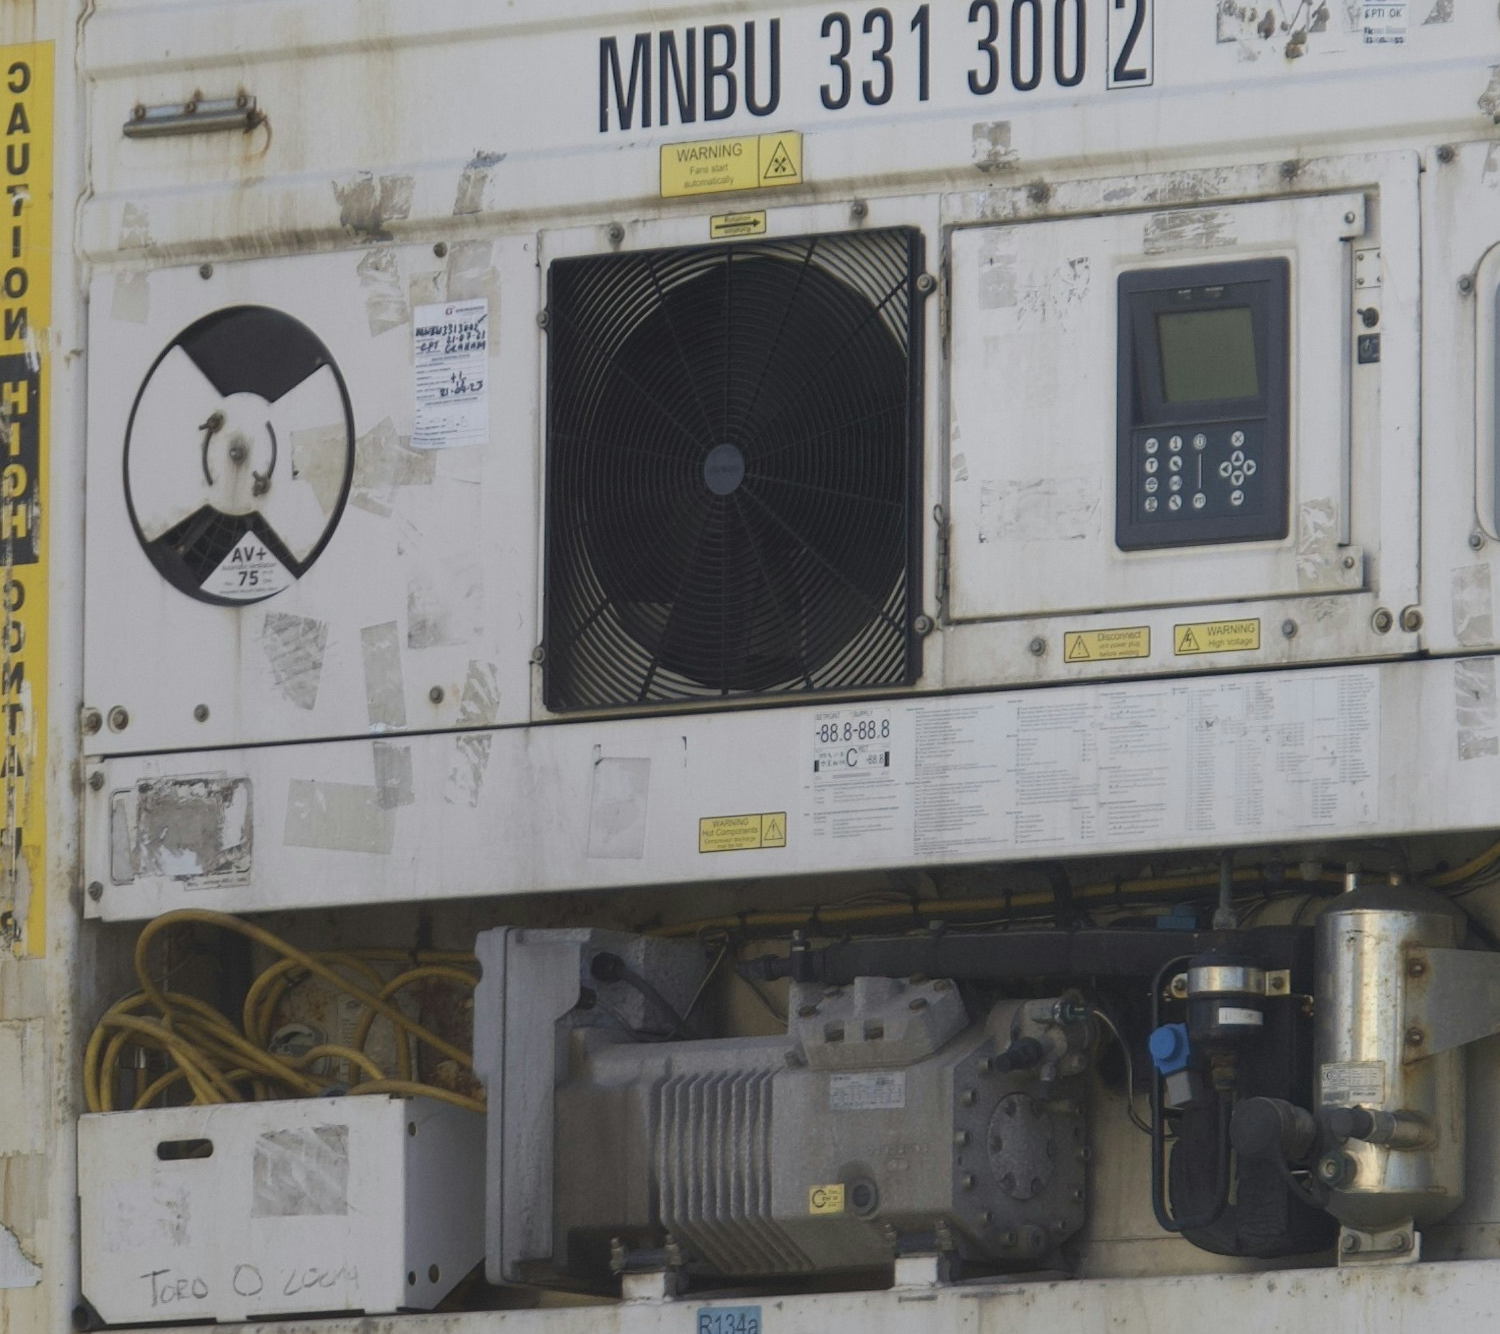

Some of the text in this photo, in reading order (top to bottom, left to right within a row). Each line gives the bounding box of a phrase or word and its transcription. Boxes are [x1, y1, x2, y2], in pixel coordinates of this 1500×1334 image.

[599, 17, 781, 133] MNBU
[819, 1, 930, 111] 331
[677, 142, 743, 162] WARNING
[711, 163, 728, 174] start
[684, 175, 734, 189] automatically
[232, 546, 267, 563] AV+
[238, 570, 259, 586] 75
[1097, 630, 1141, 642] Disconnect
[1207, 622, 1256, 636] WARNING
[1208, 639, 1225, 648] High
[715, 827, 759, 837] Components
